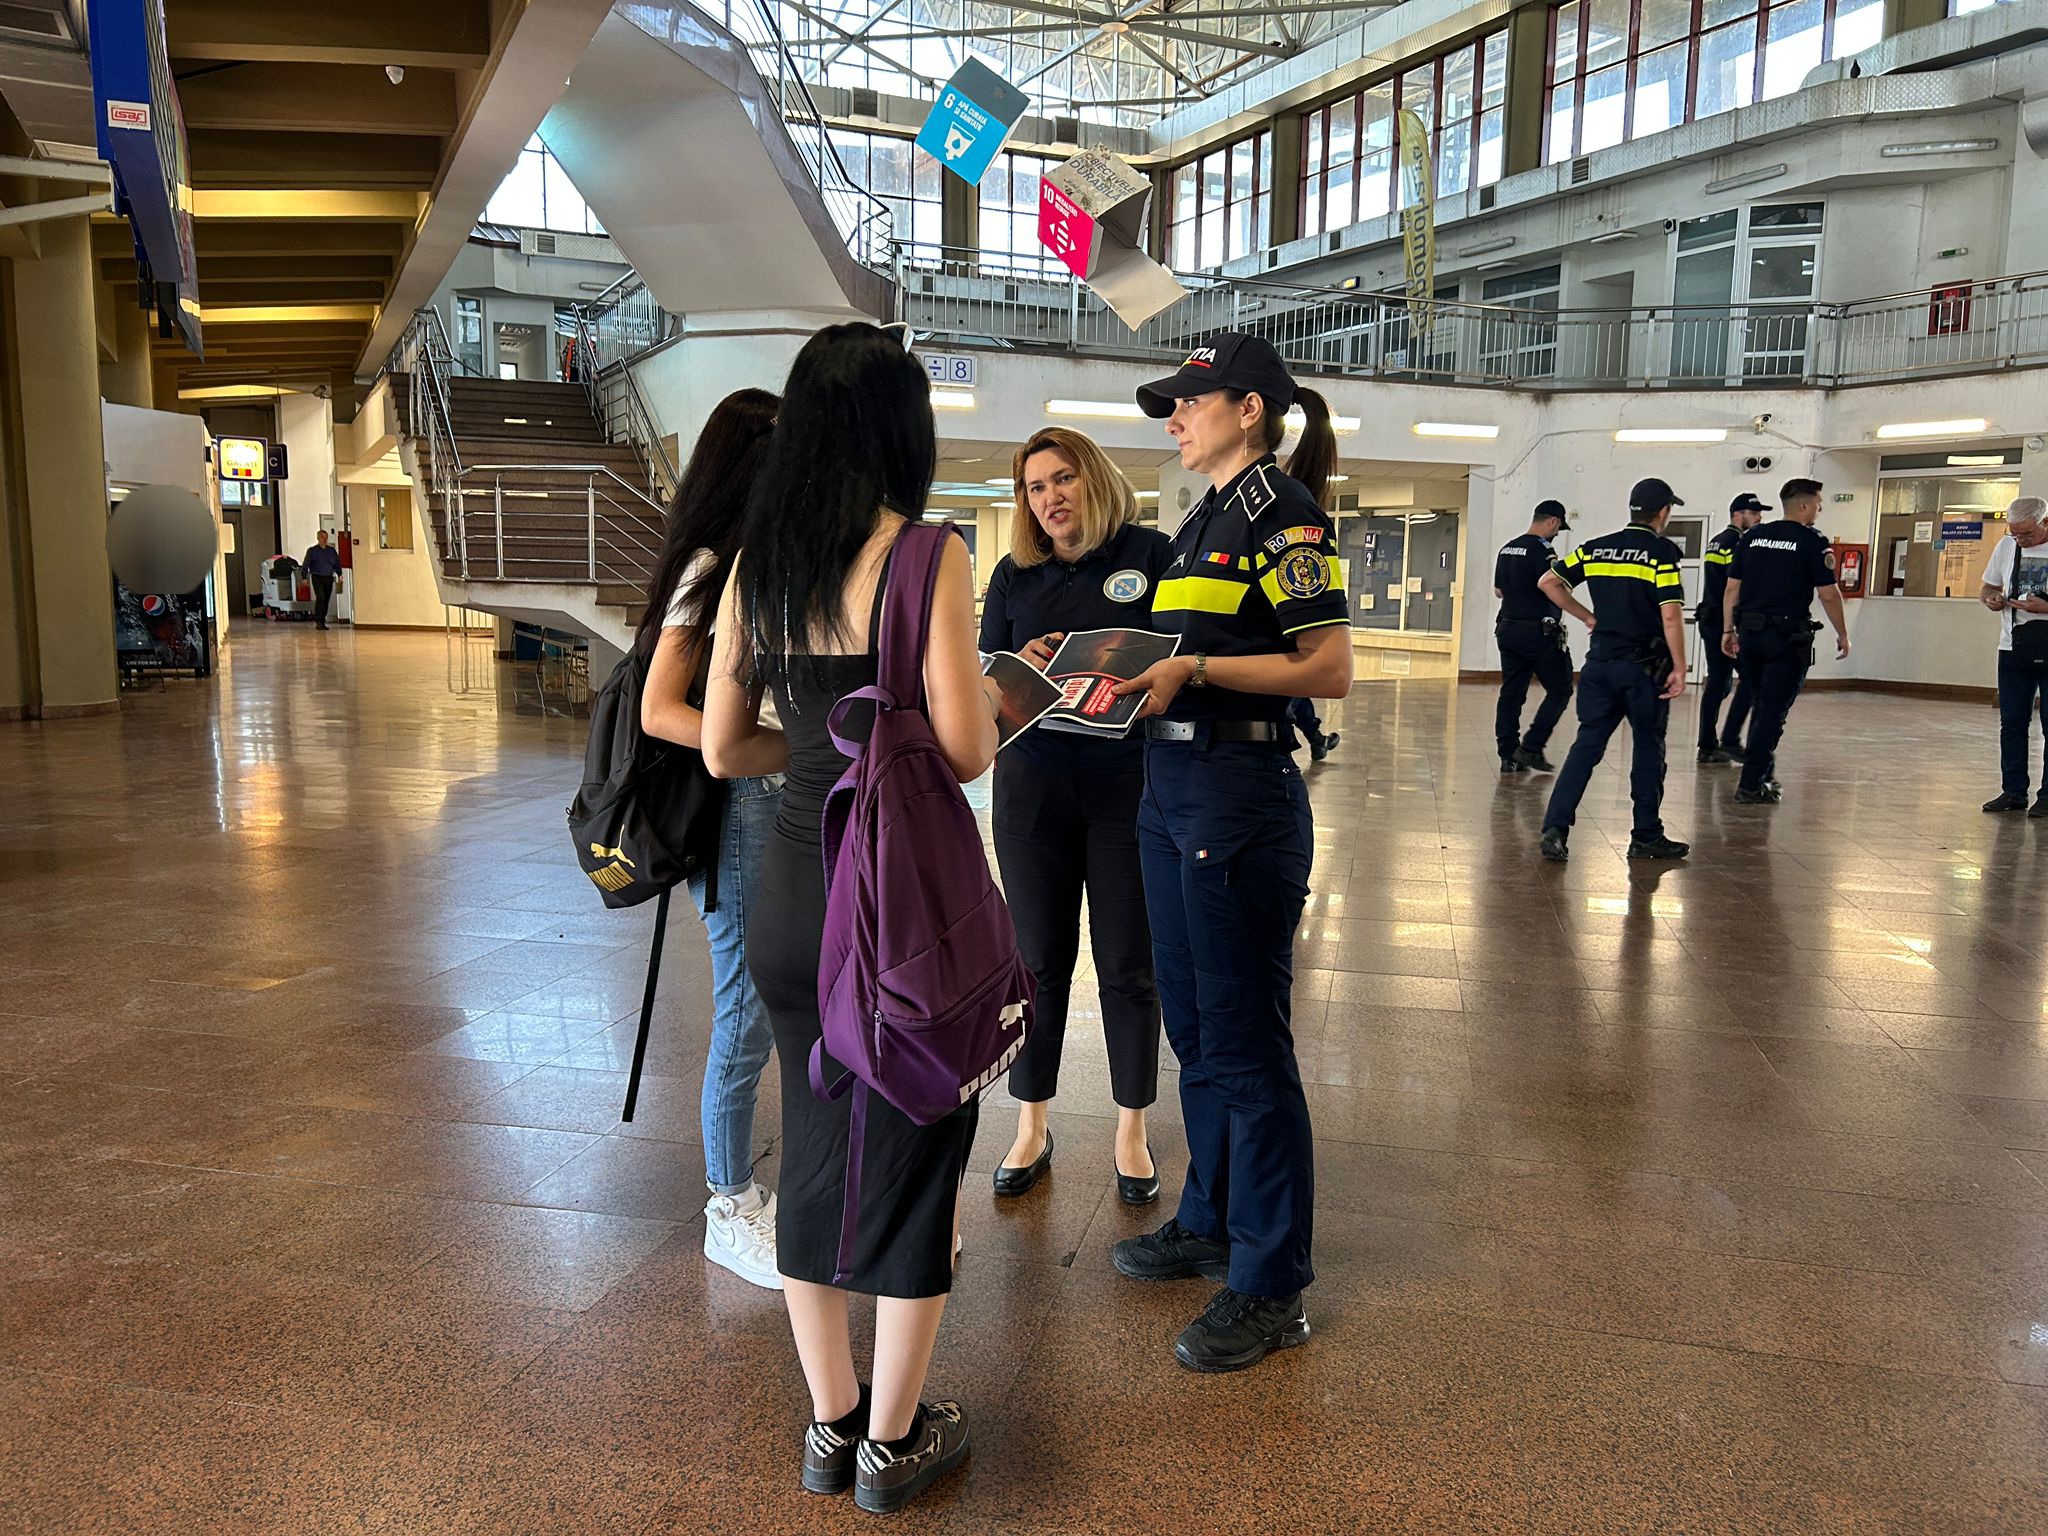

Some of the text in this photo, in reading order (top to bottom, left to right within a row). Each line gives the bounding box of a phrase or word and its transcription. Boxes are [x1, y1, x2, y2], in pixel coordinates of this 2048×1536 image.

[944, 93, 955, 108] 6
[1085, 152, 1137, 194] OBIECTIVELE
[1043, 184, 1055, 205] 10
[955, 361, 967, 379] 8
[269, 457, 278, 468] C
[1366, 552, 1372, 567] 2
[1441, 552, 1447, 568] 1
